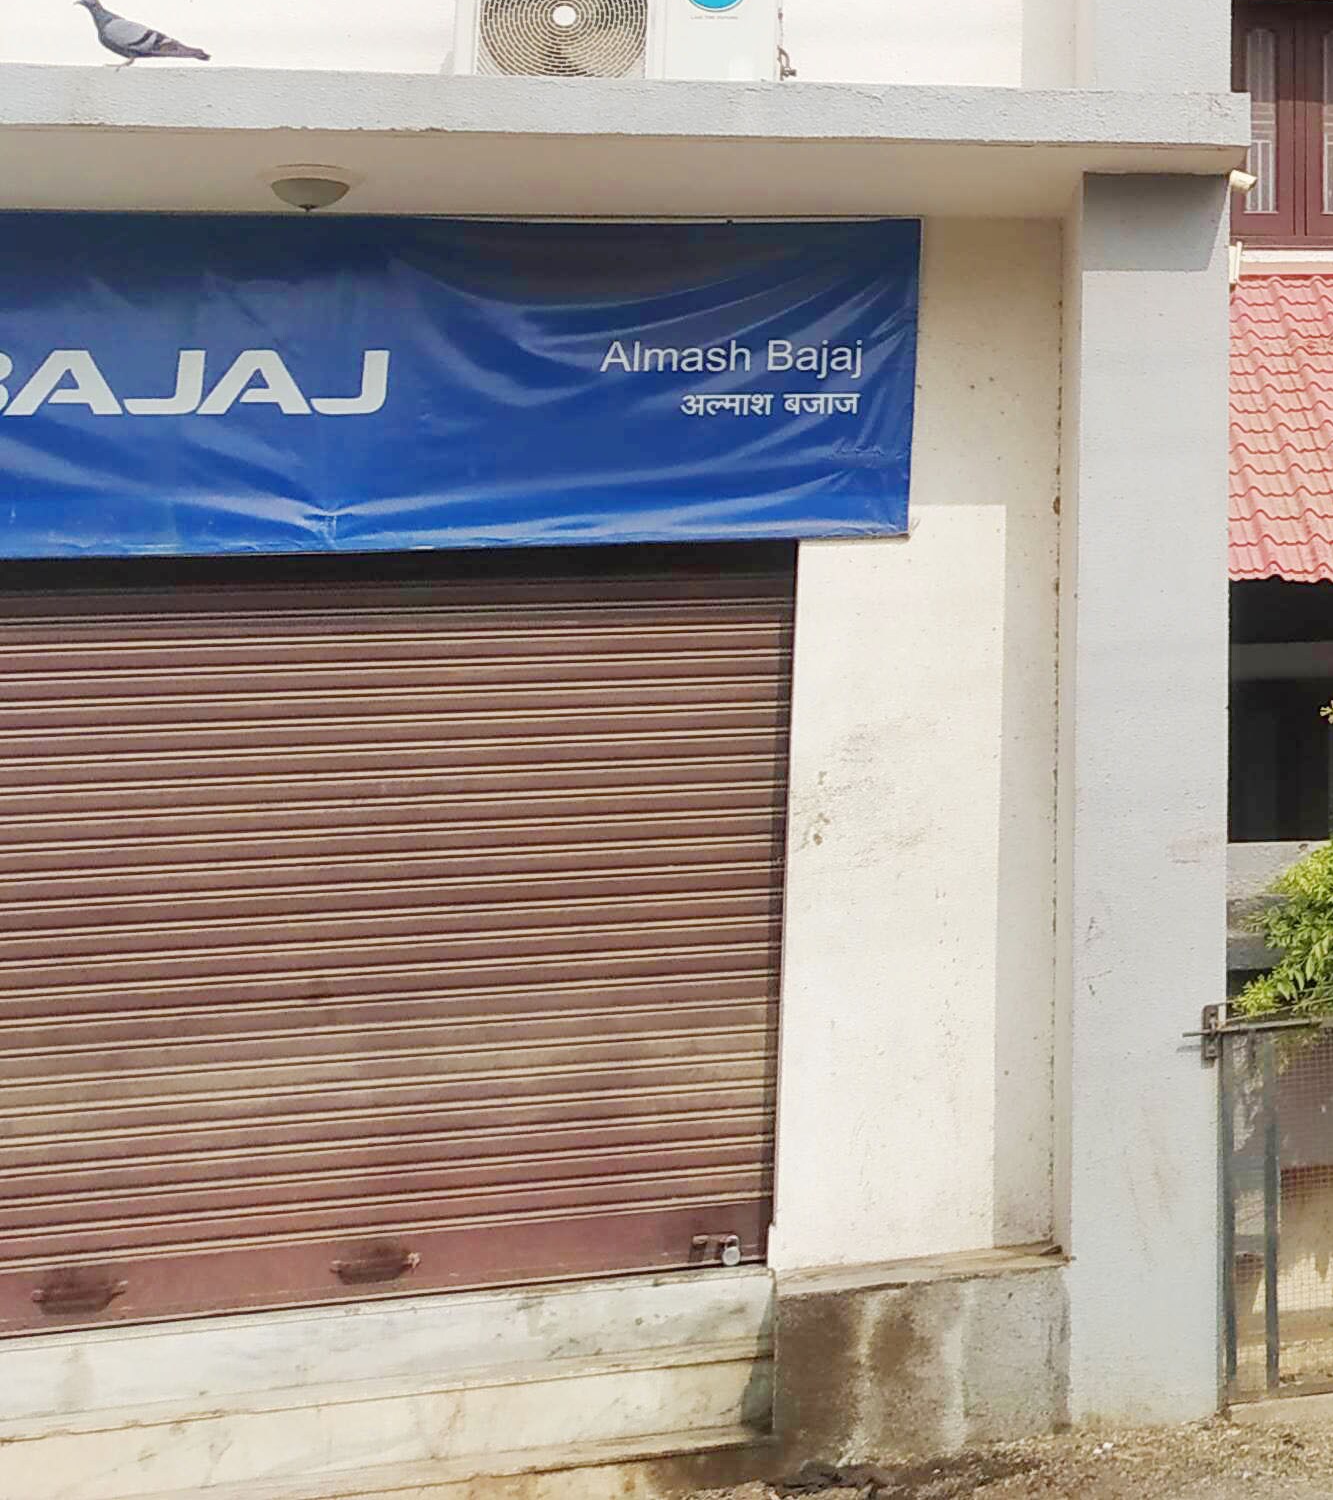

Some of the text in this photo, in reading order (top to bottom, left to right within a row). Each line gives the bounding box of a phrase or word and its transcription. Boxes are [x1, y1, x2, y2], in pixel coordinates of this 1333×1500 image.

[599, 339, 863, 380] Almash Bajaj
[0, 349, 390, 416] AJAJ
[680, 392, 861, 416] अल्माश बजाज
